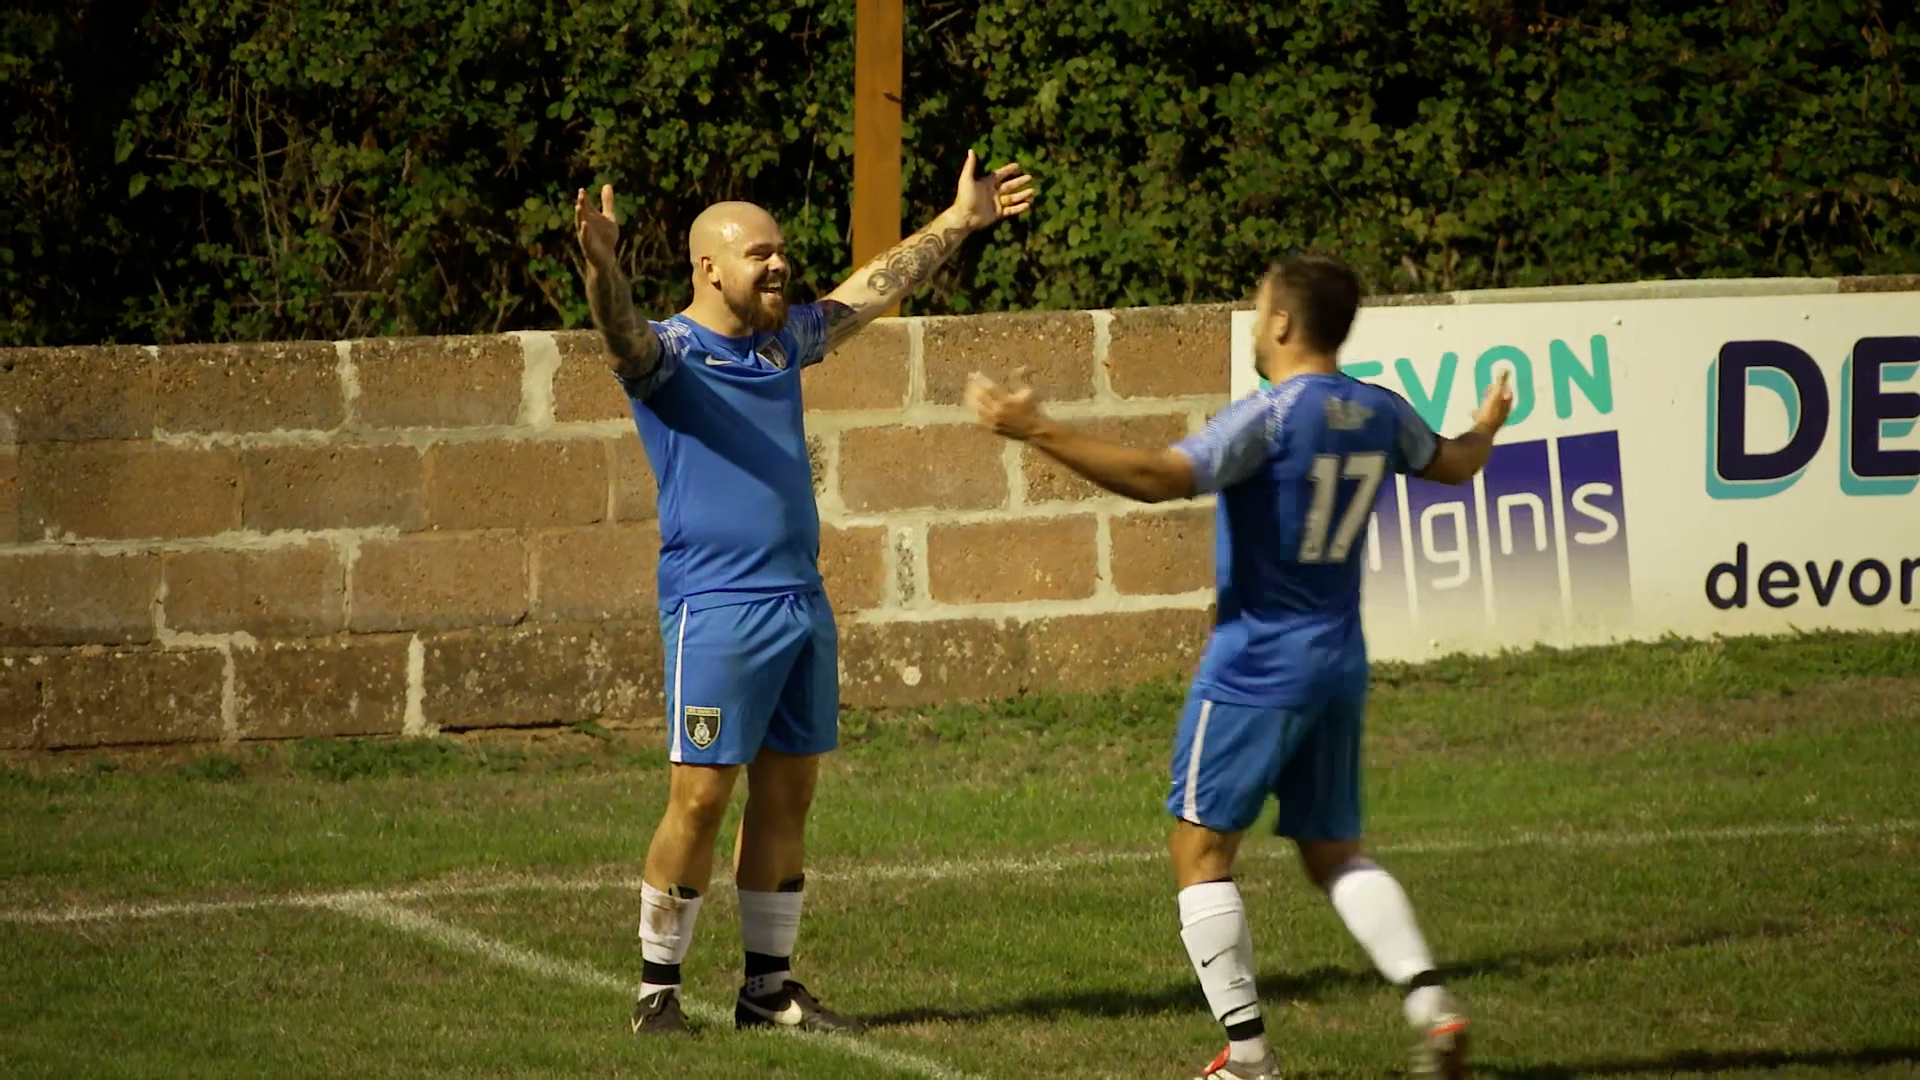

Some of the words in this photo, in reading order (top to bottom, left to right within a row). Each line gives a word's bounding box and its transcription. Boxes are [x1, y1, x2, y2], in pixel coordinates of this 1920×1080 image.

[1259, 333, 1615, 435] VON
[1298, 452, 1387, 564] 17
[1366, 482, 1620, 591] igns
